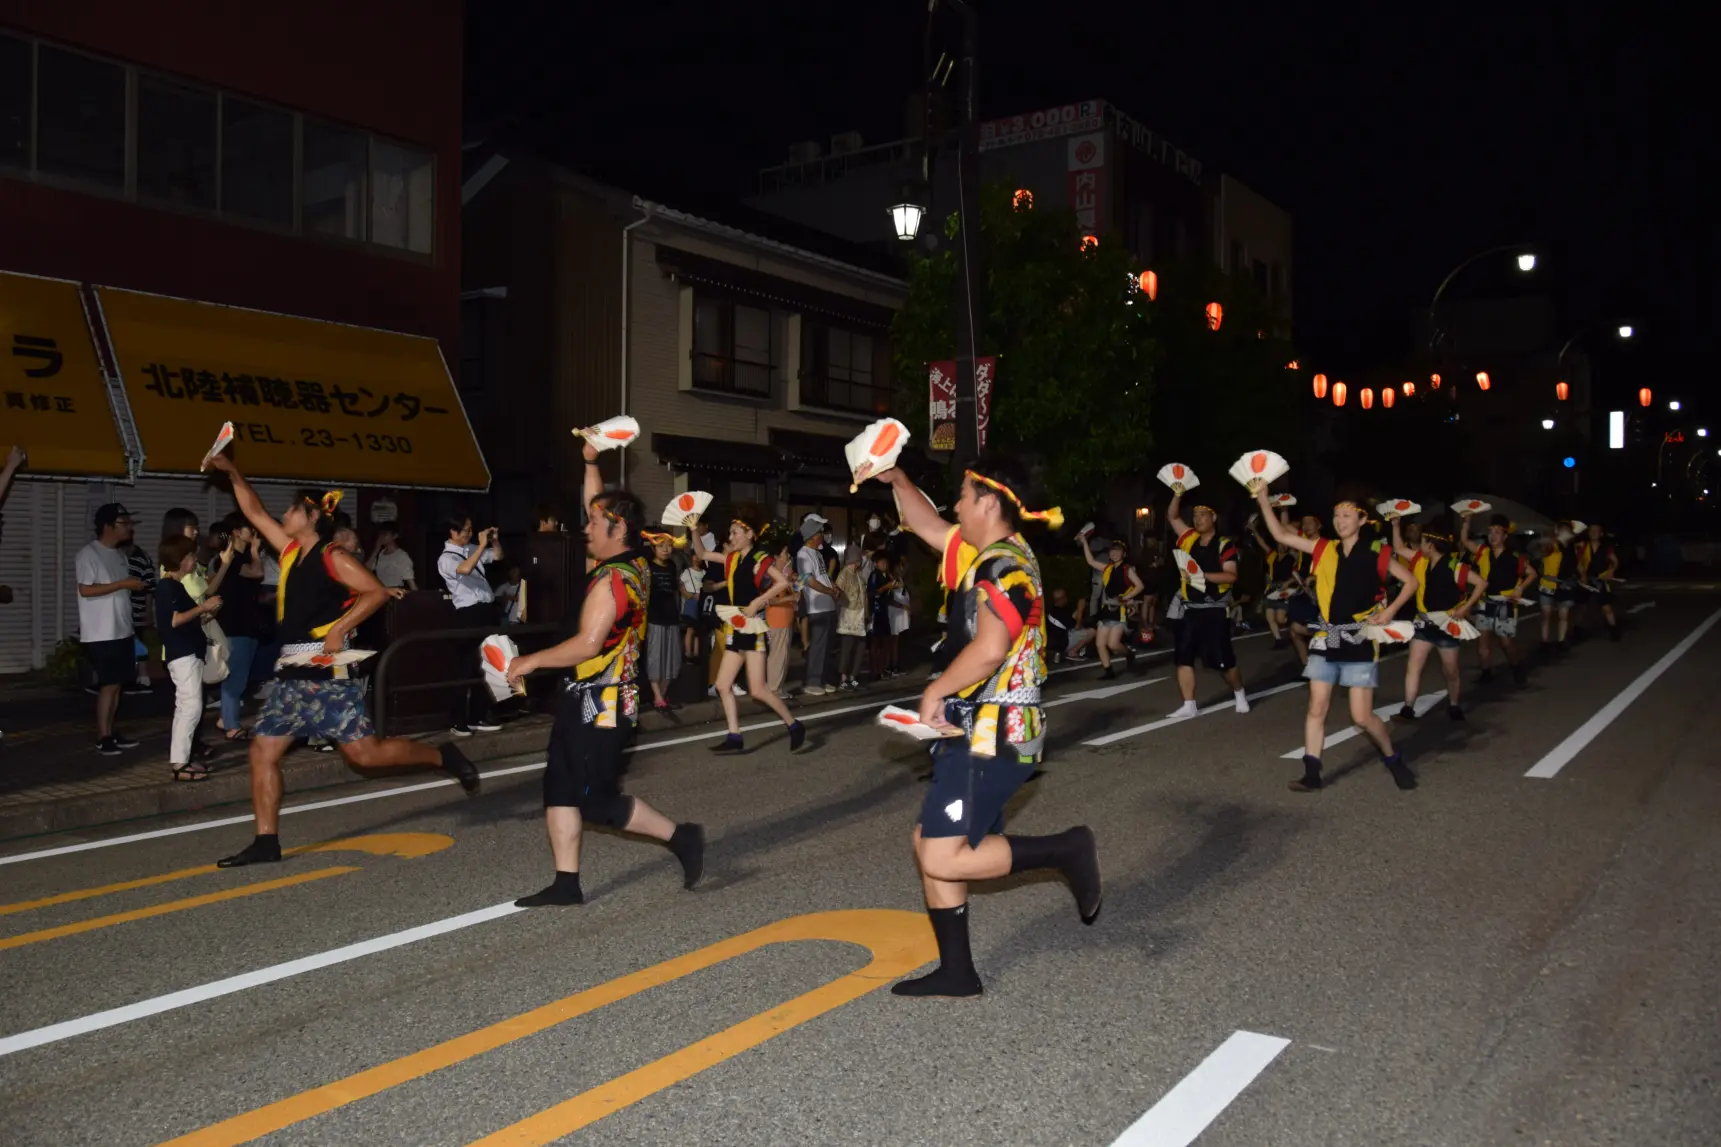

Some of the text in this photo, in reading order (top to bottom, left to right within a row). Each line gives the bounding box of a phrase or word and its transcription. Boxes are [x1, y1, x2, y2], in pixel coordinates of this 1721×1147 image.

[141, 364, 449, 421] 北陸補聴器センター
[304, 428, 413, 454] 23-1330
